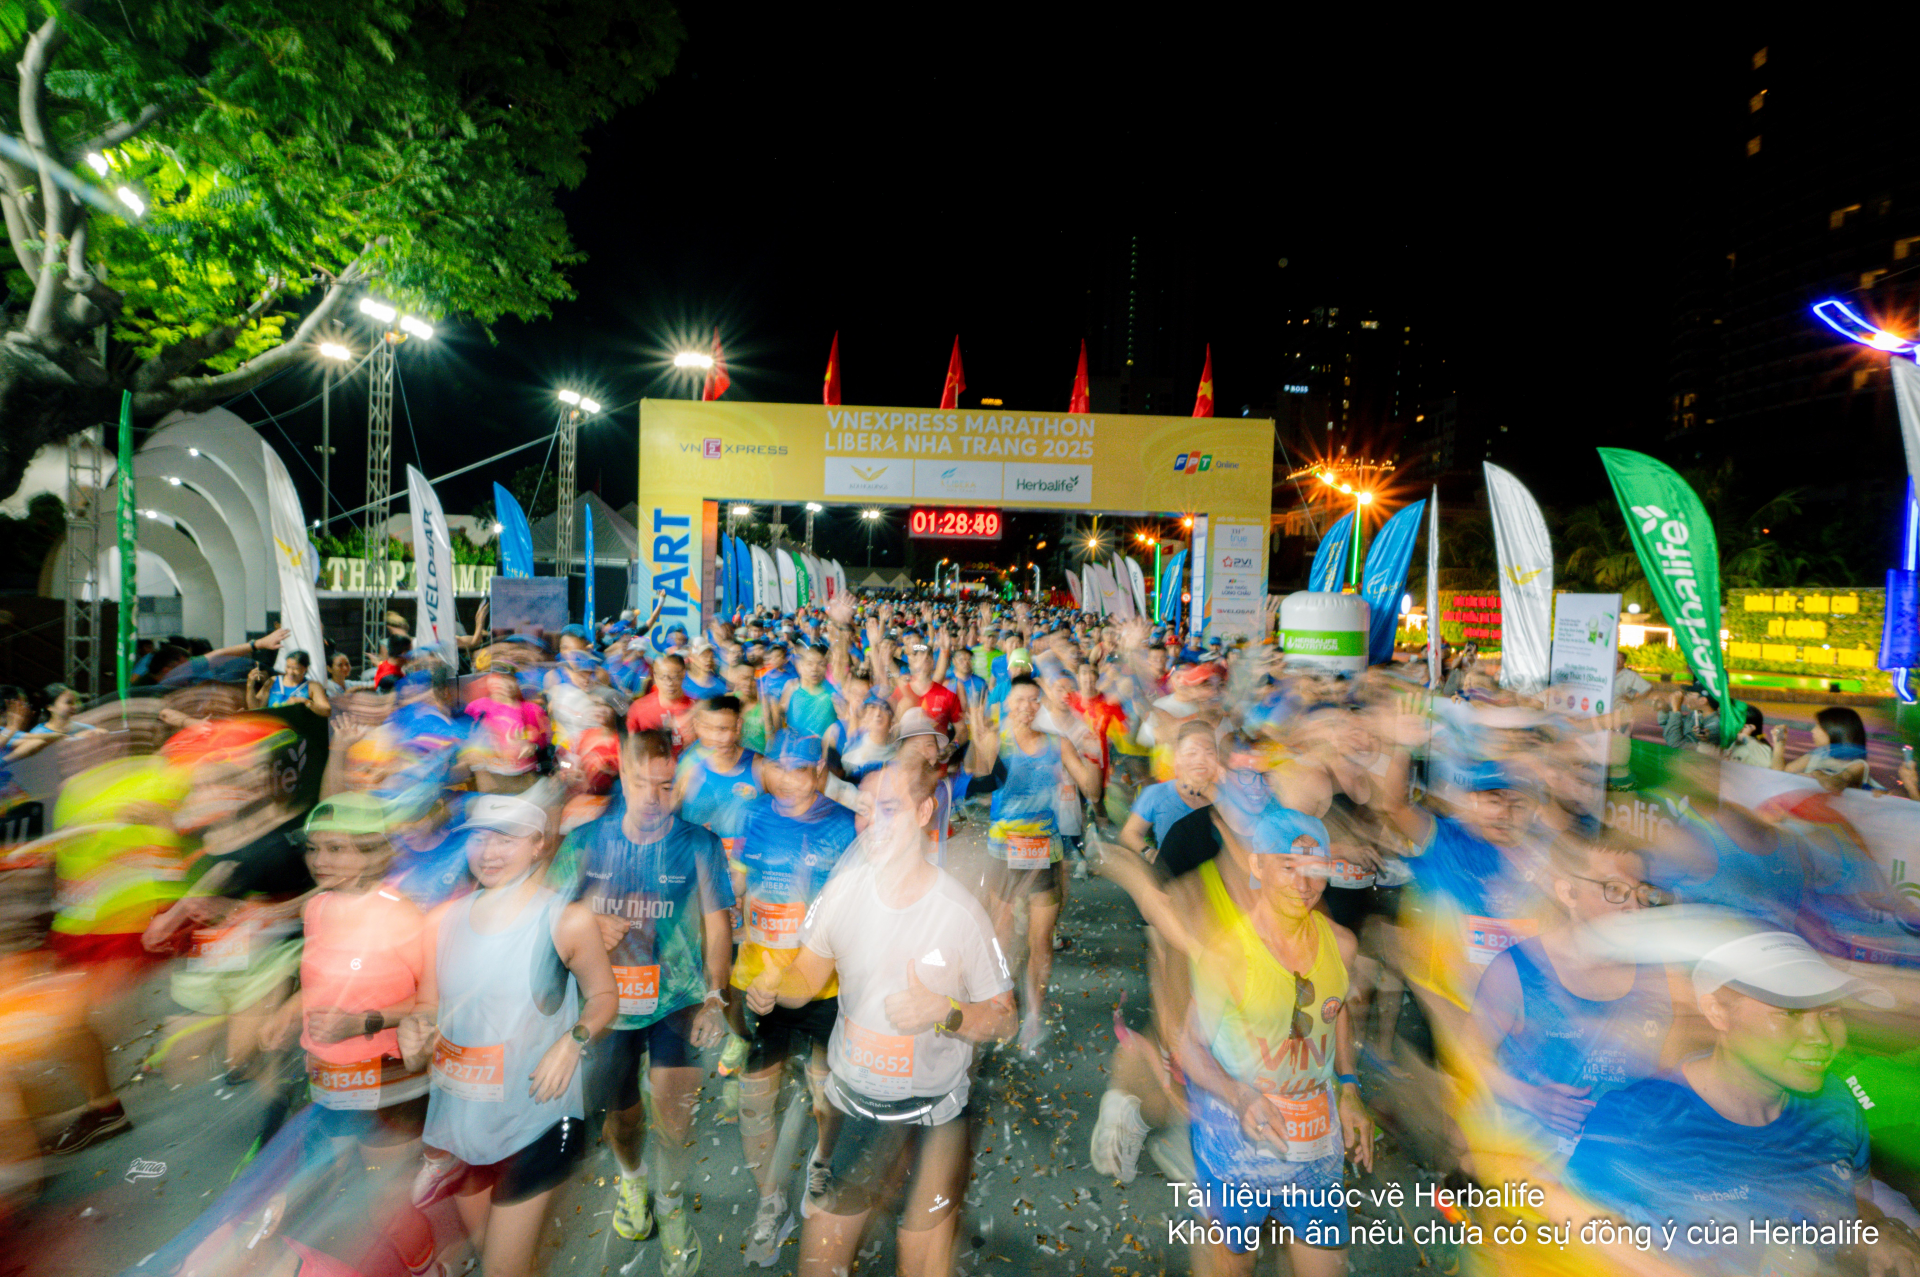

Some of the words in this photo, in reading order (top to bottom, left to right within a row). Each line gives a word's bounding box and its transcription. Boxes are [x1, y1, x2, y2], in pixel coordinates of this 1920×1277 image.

[827, 410, 959, 433] VNEXPRESS
[965, 415, 1096, 438] MARATHON
[679, 437, 789, 460] VNEXPRESS
[824, 432, 899, 453] LIBERA
[904, 434, 954, 454] NHA
[959, 436, 1038, 457] TRANG
[1042, 440, 1095, 459] 2025
[1175, 453, 1212, 473] FPT
[1216, 461, 1241, 470] Online
[1016, 476, 1074, 493] Herbalife
[1233, 558, 1253, 566] PVI
[650, 507, 691, 656] START
[1656, 519, 1722, 697] Herbalife
[1295, 636, 1339, 645] HERBALIFE
[1295, 643, 1339, 651] NUTRITION
[761, 882, 790, 891] LIBERA
[760, 916, 799, 932] 83171
[617, 981, 655, 996] 1454
[444, 1058, 497, 1081] 82777
[852, 1046, 911, 1073] 80652
[322, 1069, 377, 1089] 81346
[1845, 1074, 1876, 1111] RUN
[1287, 1115, 1327, 1139] 81173
[1693, 1185, 1749, 1202] Herbalife
